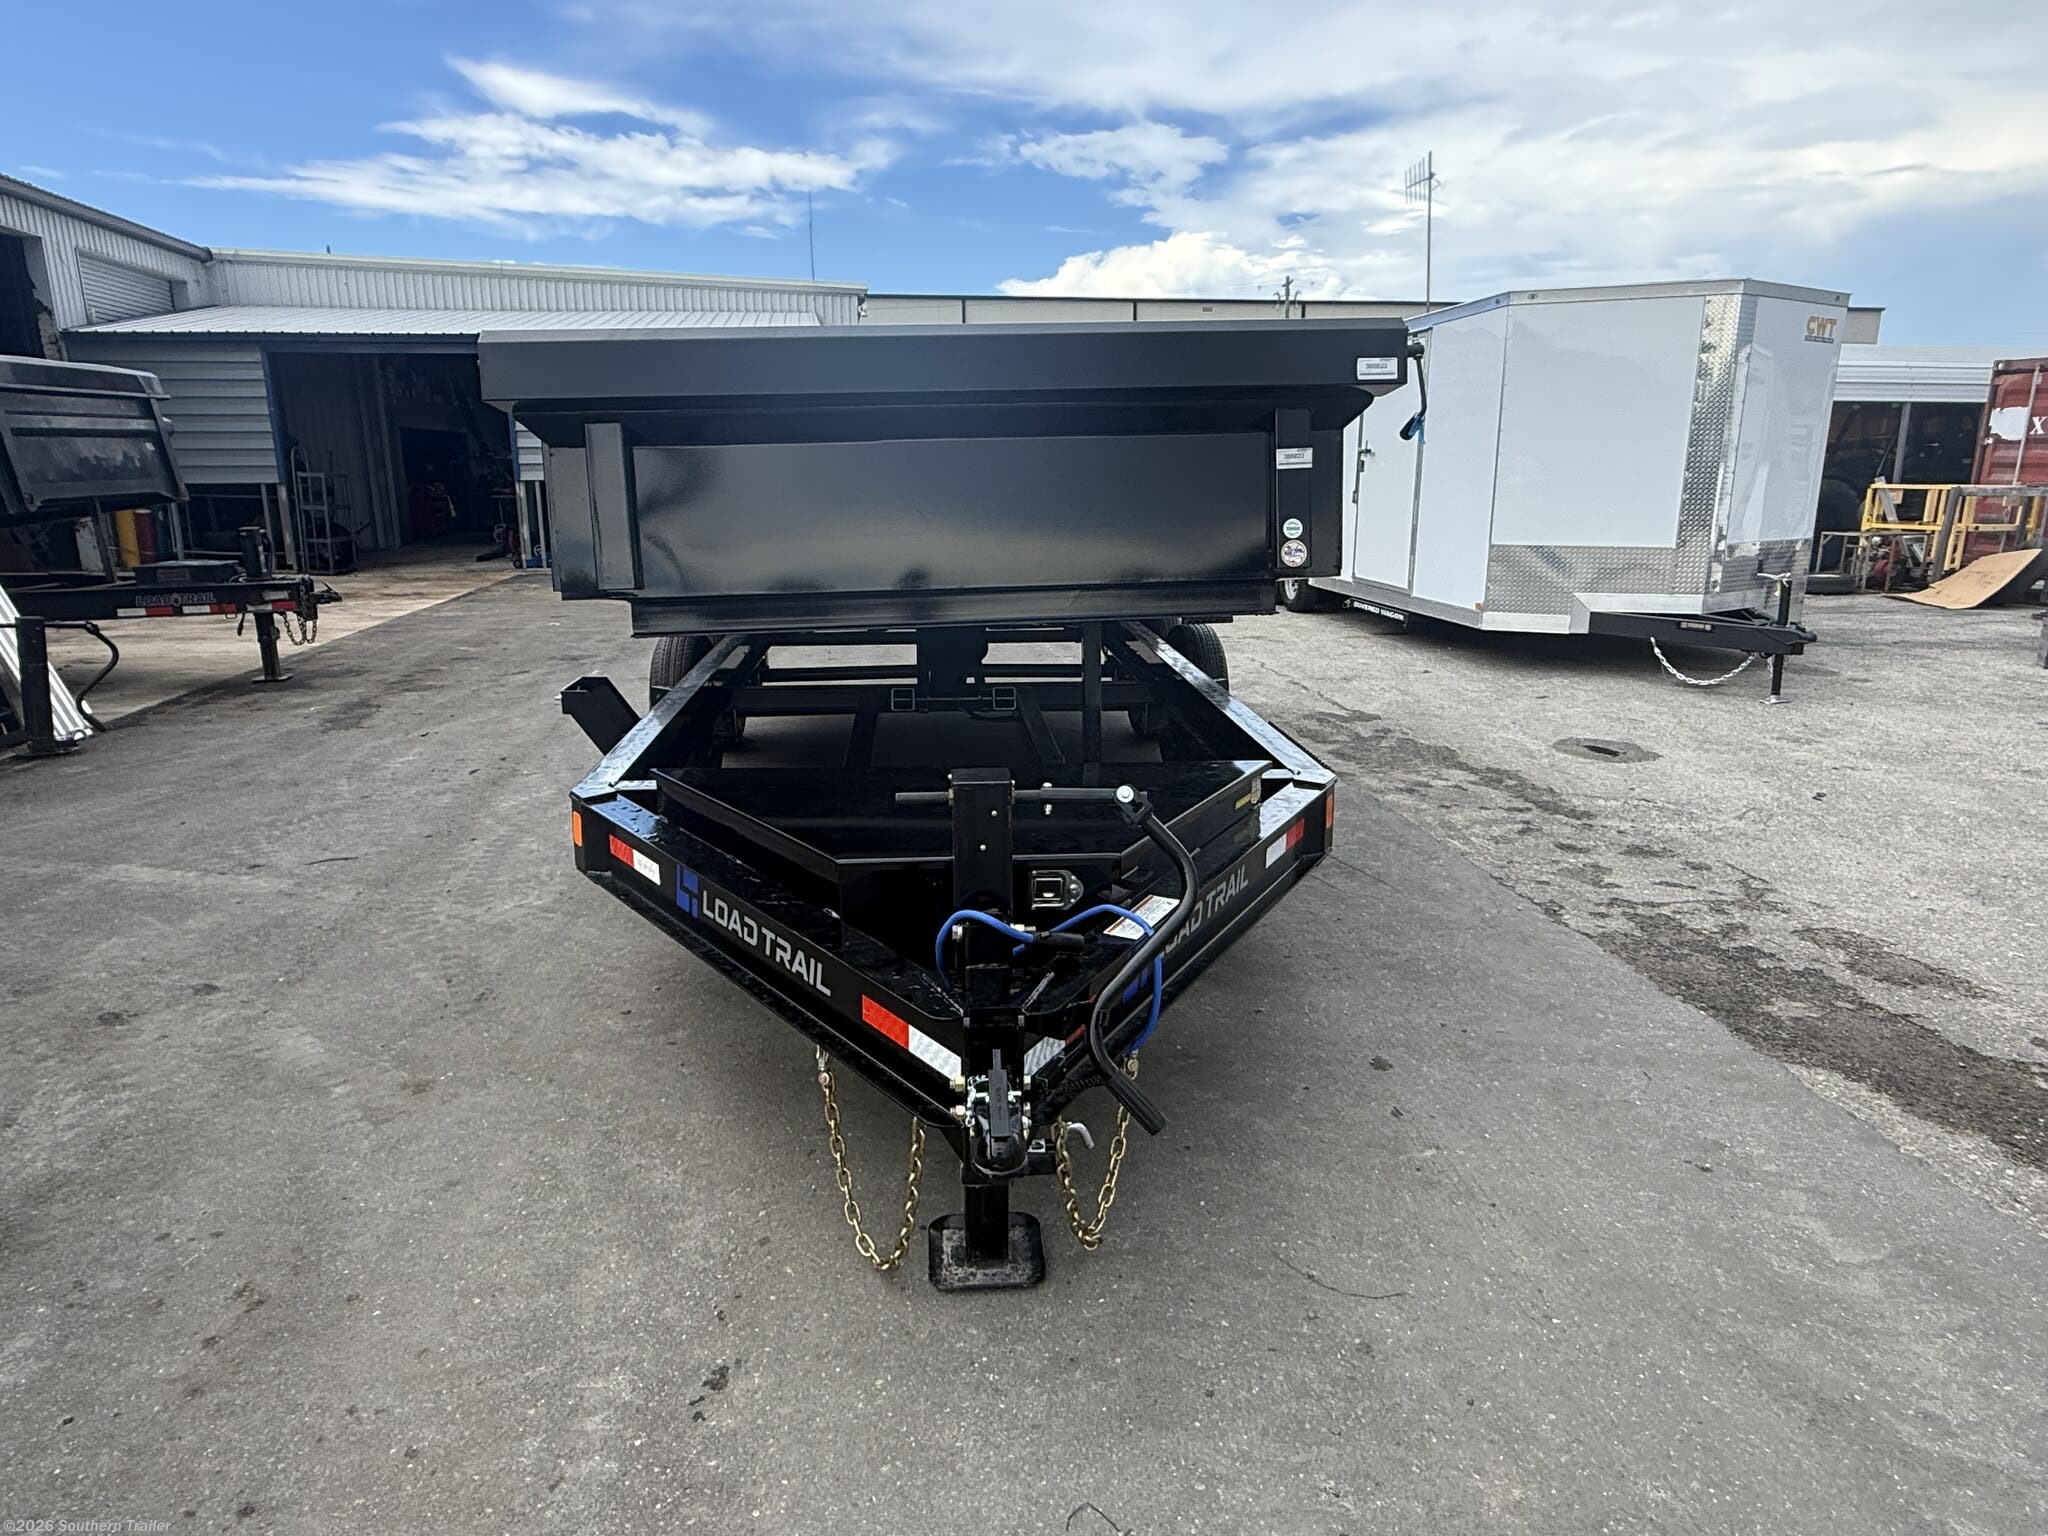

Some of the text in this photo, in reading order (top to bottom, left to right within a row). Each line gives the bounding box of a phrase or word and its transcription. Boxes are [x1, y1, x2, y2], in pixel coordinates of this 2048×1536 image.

[1806, 316, 1837, 337] CWT
[2028, 416, 2048, 435] X
[136, 592, 217, 607] LOAD TRAIL
[1380, 608, 1404, 621] WAGON
[1206, 864, 1249, 918] TRAIL
[702, 890, 831, 997] LOAD TRAIL
